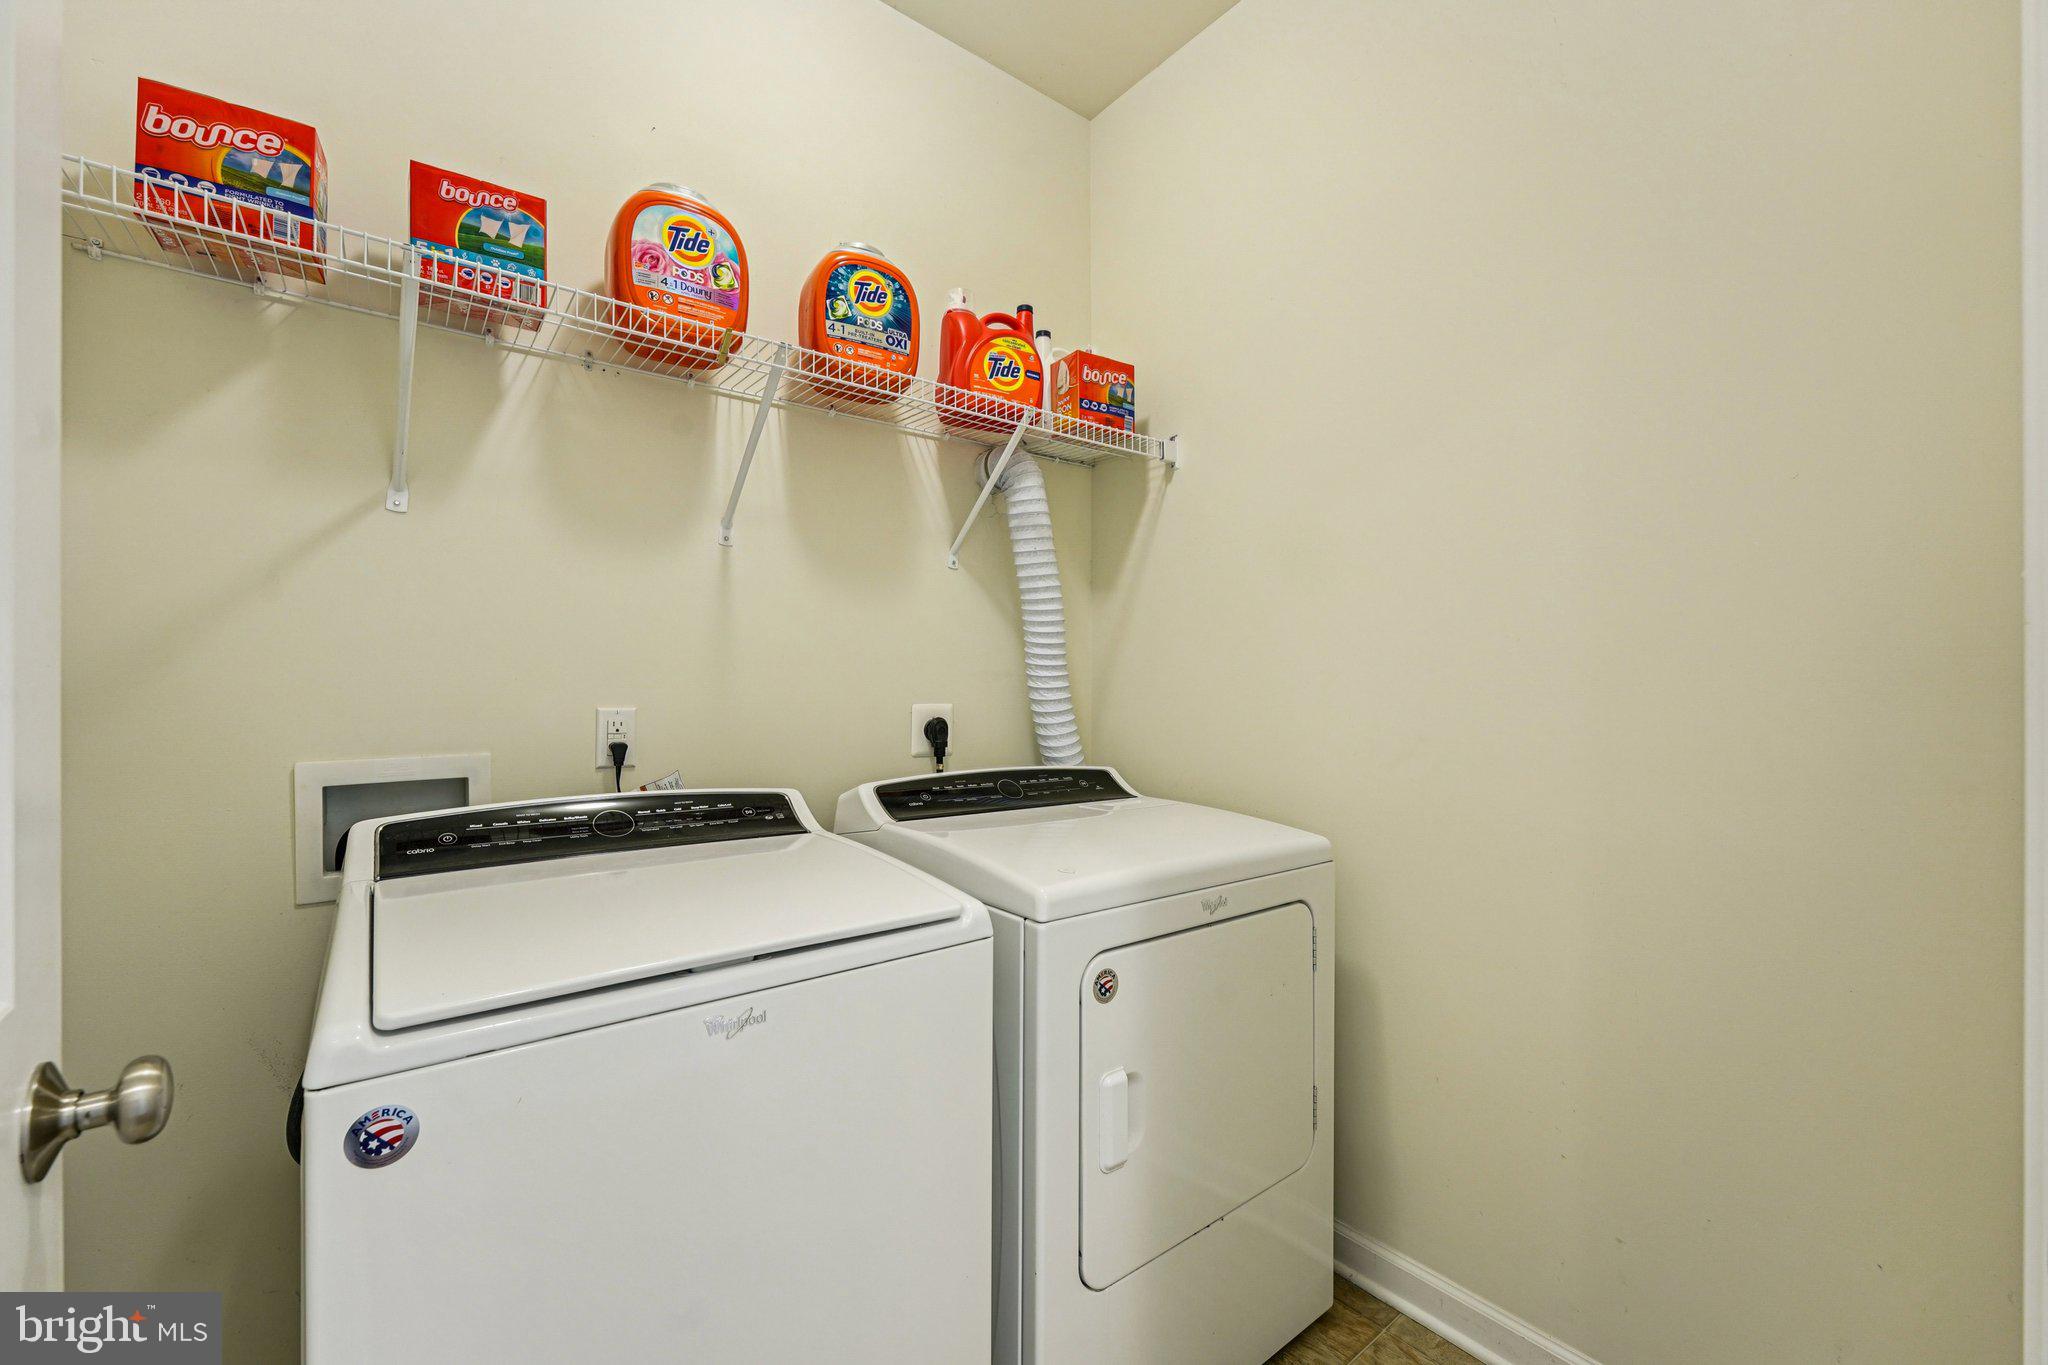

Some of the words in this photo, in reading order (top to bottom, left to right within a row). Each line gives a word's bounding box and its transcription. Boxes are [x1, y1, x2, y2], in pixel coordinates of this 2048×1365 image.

[142, 104, 283, 156] bounce
[224, 188, 273, 203] FORMULATED
[275, 199, 285, 207] TO
[440, 180, 517, 211] bounce
[668, 225, 710, 254] Tide
[672, 266, 704, 284] PODS
[680, 281, 712, 301] Downy
[854, 281, 888, 304] Tide
[857, 316, 883, 331] PODS
[888, 329, 908, 339] ULTRA
[885, 334, 907, 350] OXI
[988, 357, 1021, 380] Tide
[1082, 364, 1128, 386] bounce
[406, 847, 435, 856] cabrio
[352, 1107, 414, 1137] AMERICA
